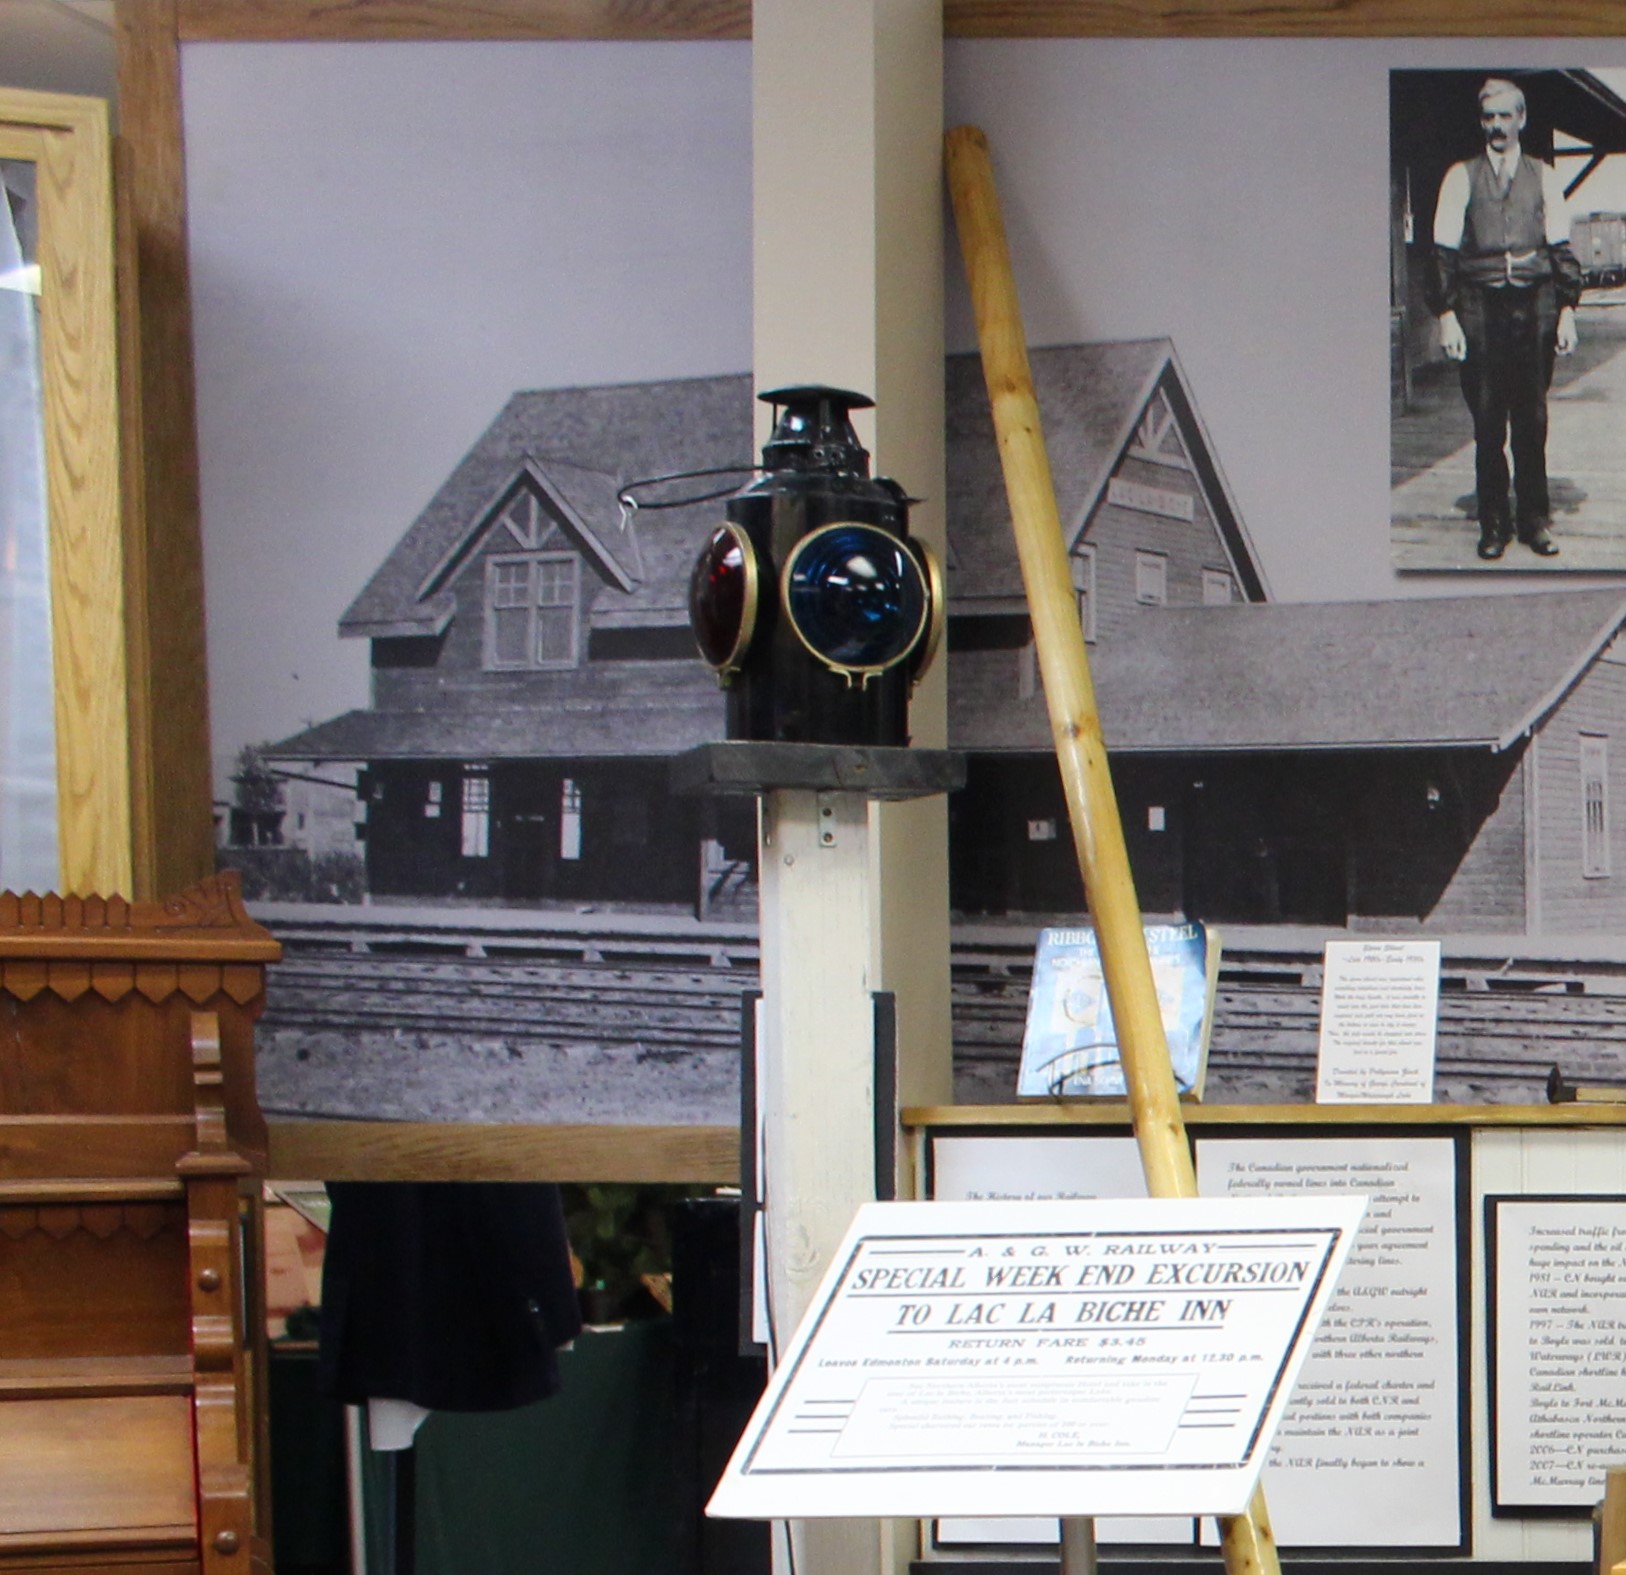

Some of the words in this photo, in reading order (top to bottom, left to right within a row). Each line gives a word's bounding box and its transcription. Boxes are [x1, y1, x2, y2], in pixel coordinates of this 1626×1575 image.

[1149, 924, 1198, 944] STEEL
[1248, 1163, 1293, 1172] Canadian
[1296, 1163, 1347, 1174] government
[1350, 1178, 1395, 1188] Canadian
[1381, 1225, 1434, 1235] government
[1529, 1226, 1576, 1236] Increased
[968, 1246, 987, 1257] A.
[1002, 1247, 1016, 1257] &
[1031, 1246, 1049, 1257] G.
[1065, 1245, 1092, 1256] W.
[1103, 1243, 1217, 1256] RAILWAY
[1381, 1241, 1428, 1251] agreement
[852, 1266, 966, 1290] SPECIAL
[985, 1265, 1070, 1287] WEEK
[1075, 1264, 1135, 1286] END
[1146, 1261, 1312, 1285] EXCURSION
[896, 1304, 932, 1326] TO
[945, 1302, 1005, 1325] LAC
[1017, 1302, 1056, 1324] LA
[1075, 1300, 1166, 1323] BICHE
[1178, 1299, 1234, 1321] INN
[947, 1338, 1026, 1349] RETURN
[1036, 1337, 1089, 1348] FARE
[1099, 1336, 1147, 1348] $3.45
[818, 1358, 857, 1368] Leaves
[862, 1357, 921, 1367] Edmonton
[925, 1357, 981, 1368] Saturday
[984, 1357, 999, 1366] at
[1003, 1356, 1010, 1366] 4
[1013, 1357, 1040, 1367] p.m.
[1065, 1355, 1127, 1365] Returning
[1132, 1354, 1179, 1364] Monday
[1182, 1354, 1196, 1363] at
[1202, 1353, 1235, 1363] 12.30
[1238, 1354, 1265, 1363] p.m.
[1529, 1366, 1575, 1377] Canadian
